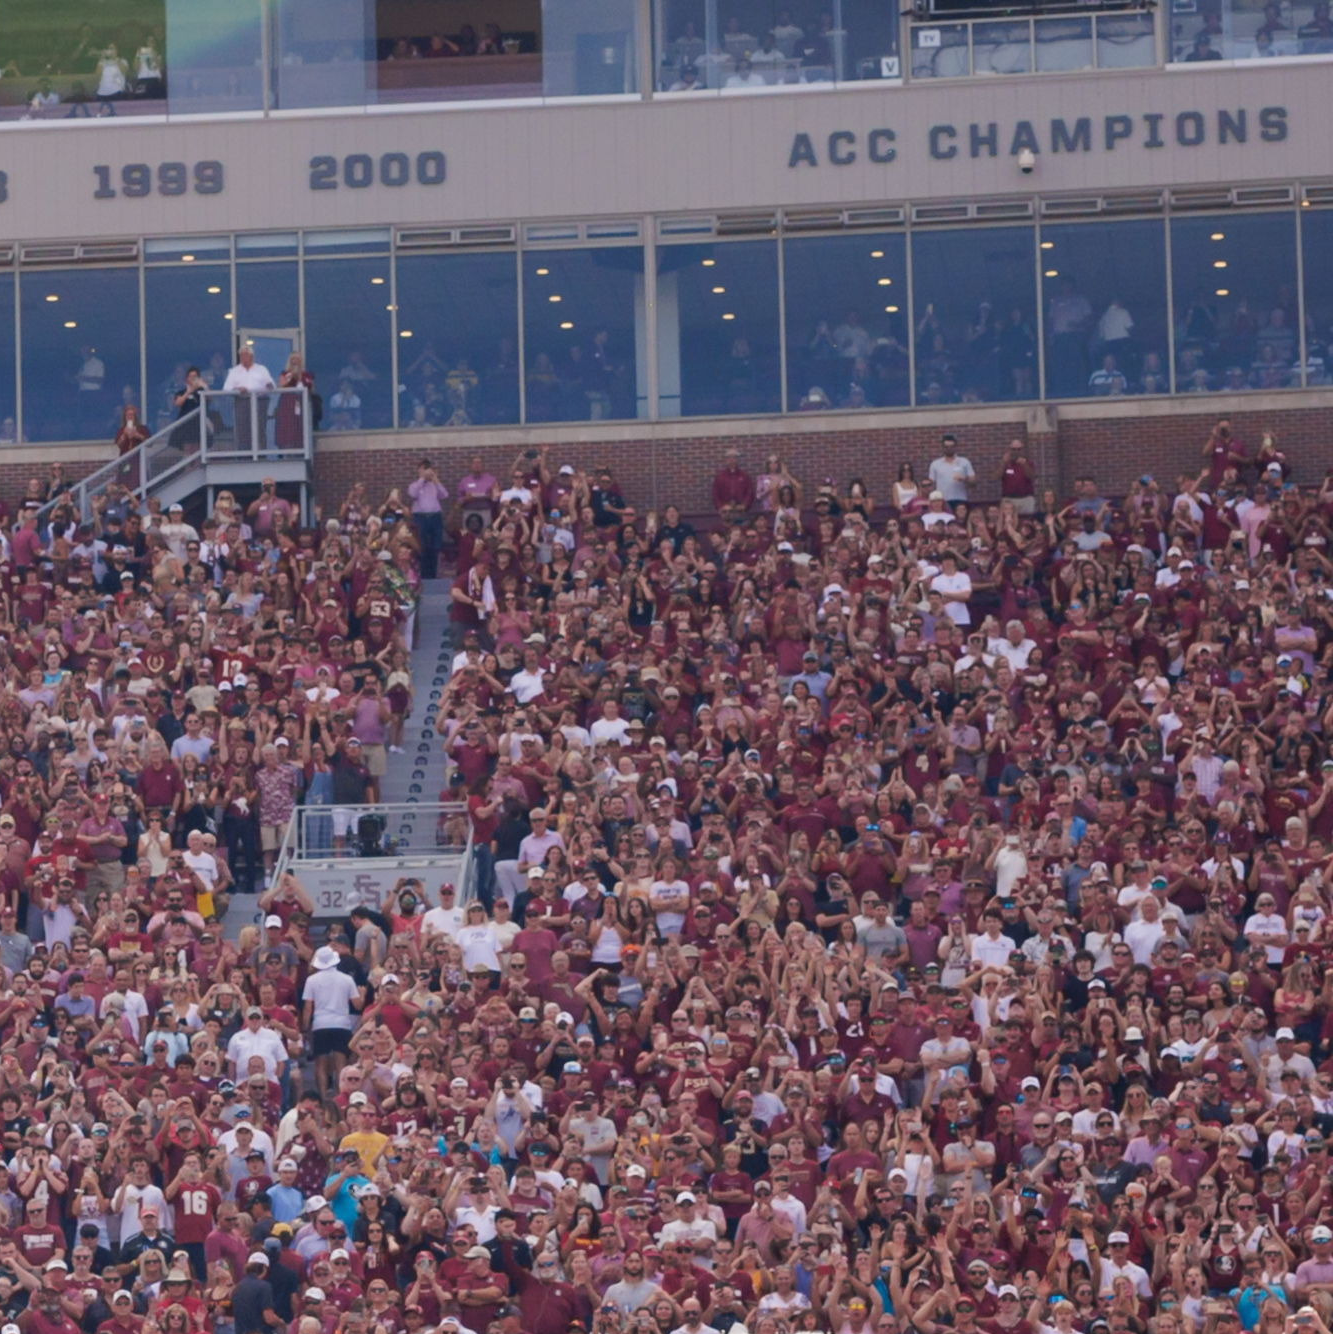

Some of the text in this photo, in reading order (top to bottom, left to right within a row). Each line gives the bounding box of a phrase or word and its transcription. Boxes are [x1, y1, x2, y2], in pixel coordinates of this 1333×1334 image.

[923, 34, 936, 43] TV
[884, 61, 896, 72] V
[788, 106, 1290, 168] ACC CHAMPIONS
[93, 160, 224, 200] 1999
[309, 151, 447, 191] 2000
[321, 890, 343, 908] 32
[684, 1077, 709, 1088] FSU
[33, 1178, 49, 1203] 4
[180, 1189, 208, 1216] 16
